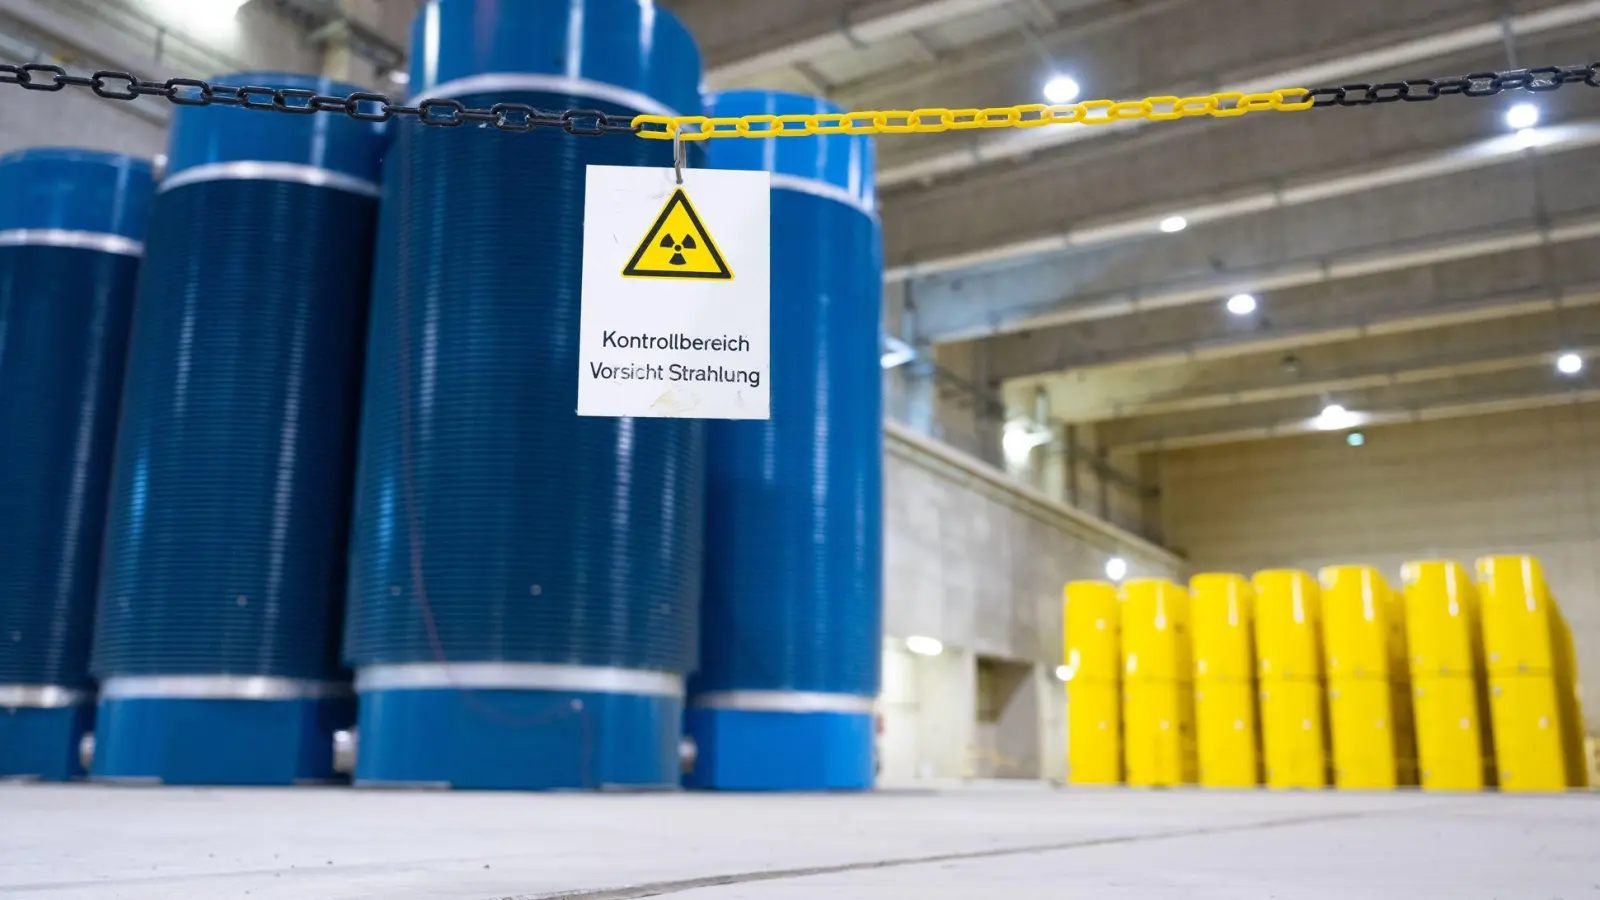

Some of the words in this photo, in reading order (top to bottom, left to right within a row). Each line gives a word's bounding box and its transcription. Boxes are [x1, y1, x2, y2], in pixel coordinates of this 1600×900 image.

[602, 330, 750, 352] Kontrollbereich
[590, 361, 664, 381] Vorsicht
[668, 363, 761, 388] Strahlung
